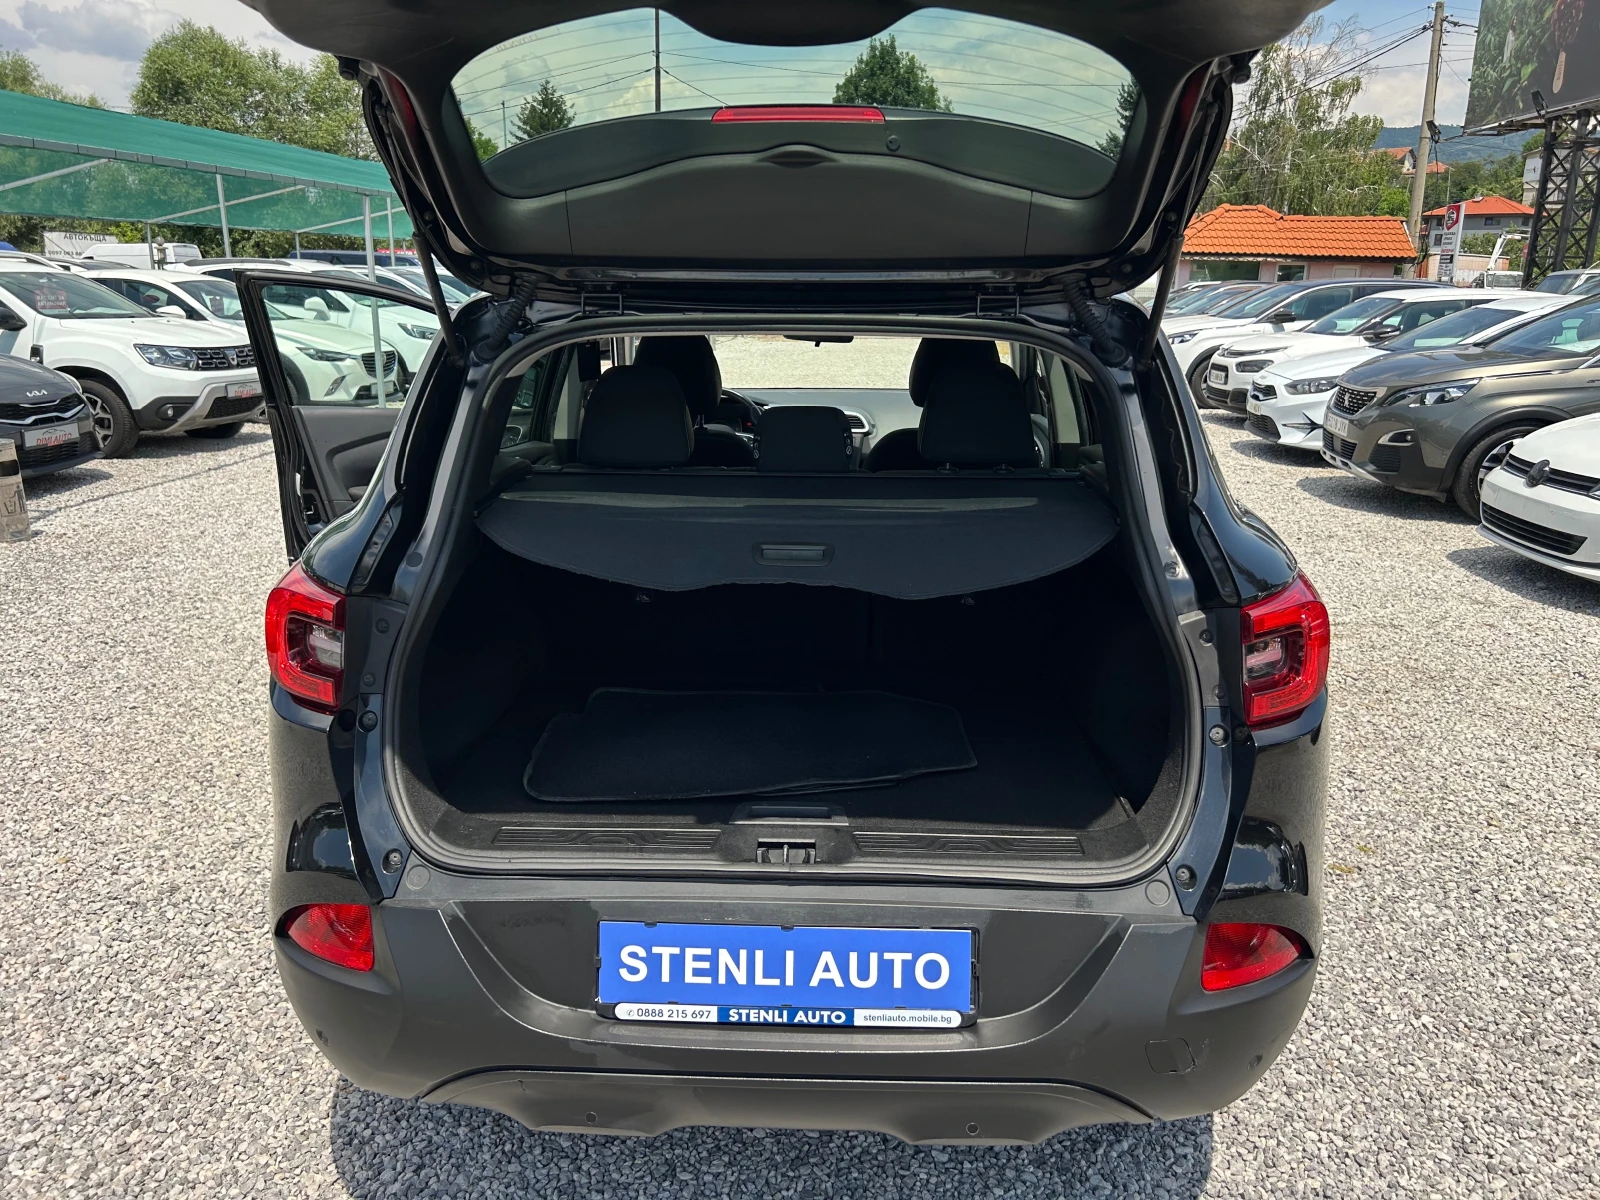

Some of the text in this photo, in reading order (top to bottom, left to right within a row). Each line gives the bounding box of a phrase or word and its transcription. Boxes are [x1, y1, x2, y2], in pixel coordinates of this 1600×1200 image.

[63, 233, 107, 242] АВТОКЪЩА
[54, 432, 72, 442] AUTO
[618, 944, 950, 990] STENLI AUTO
[636, 1007, 712, 1020] 0888 215 697
[728, 1009, 847, 1024] STENLI AUTO
[863, 1013, 952, 1024] stenliauto.mobile.bg
